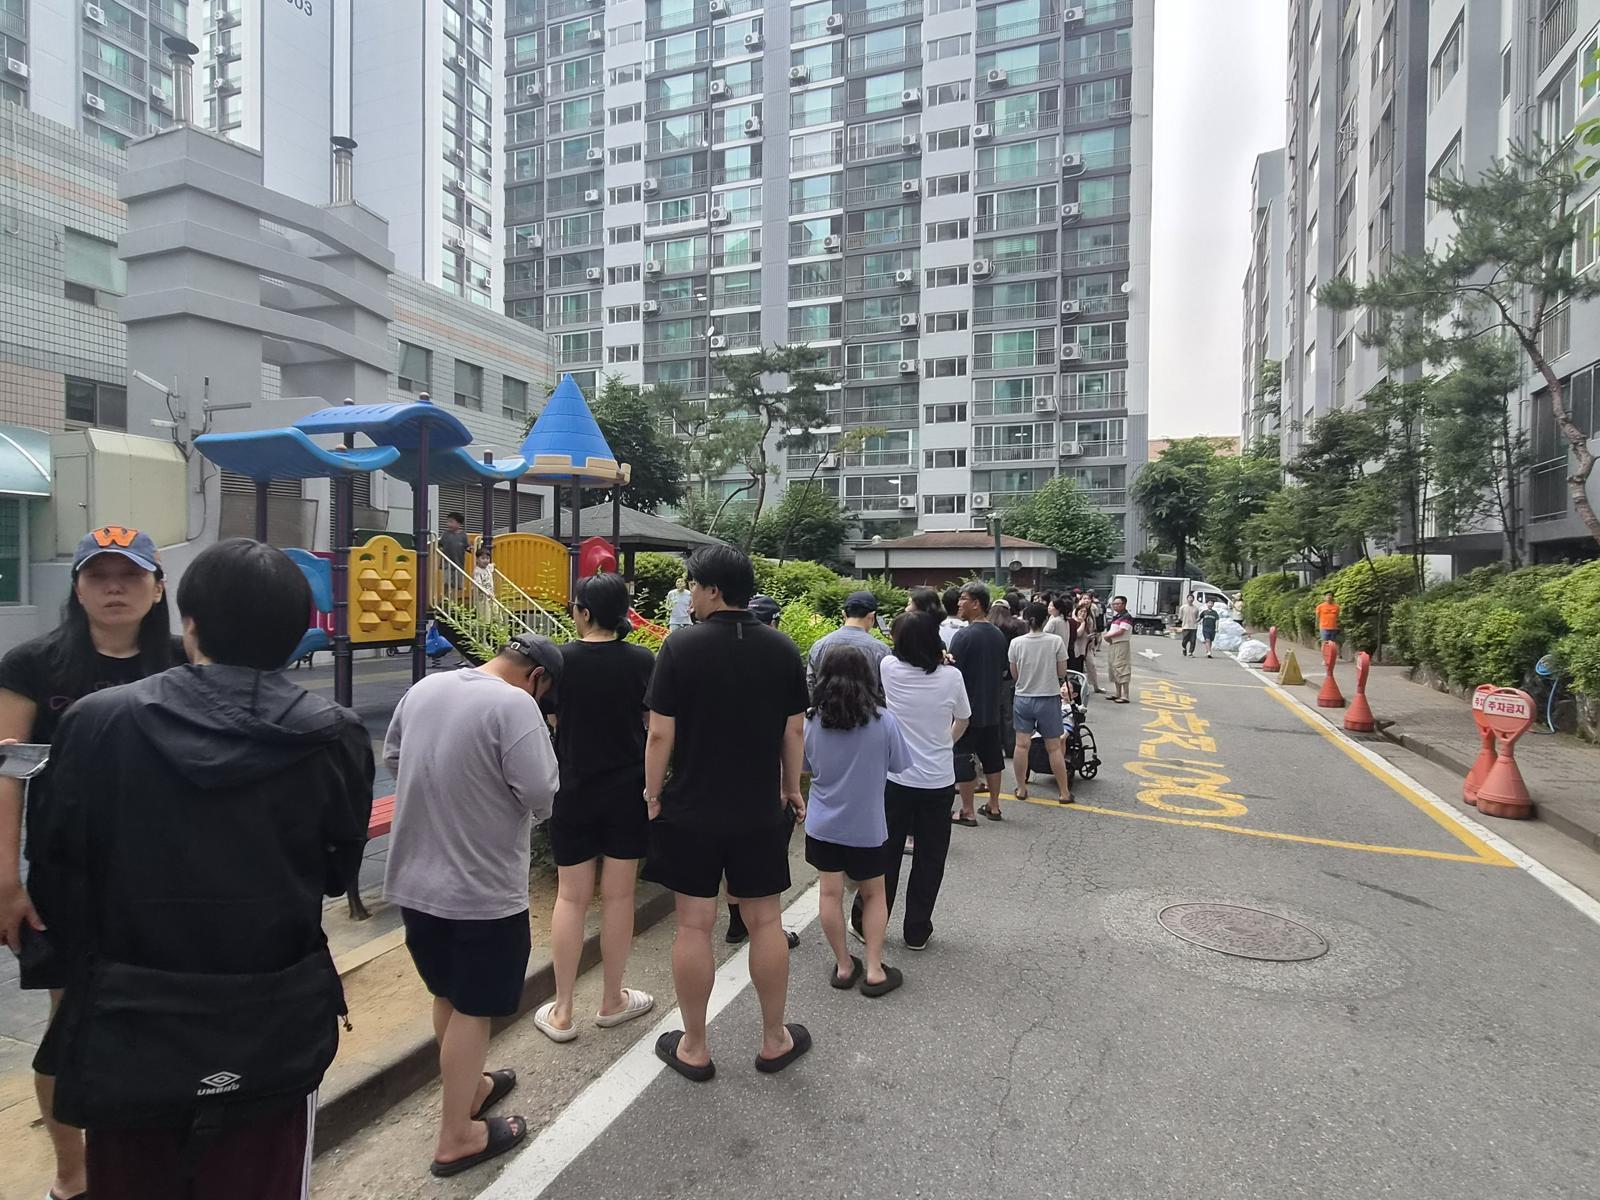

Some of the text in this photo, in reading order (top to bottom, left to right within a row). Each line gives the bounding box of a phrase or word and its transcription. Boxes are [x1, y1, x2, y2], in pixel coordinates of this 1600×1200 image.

[286, 0, 312, 17] 03
[1488, 701, 1525, 715] 주차금지
[1123, 679, 1248, 816] 소방차전용
[196, 1082, 240, 1096] UMBRO
